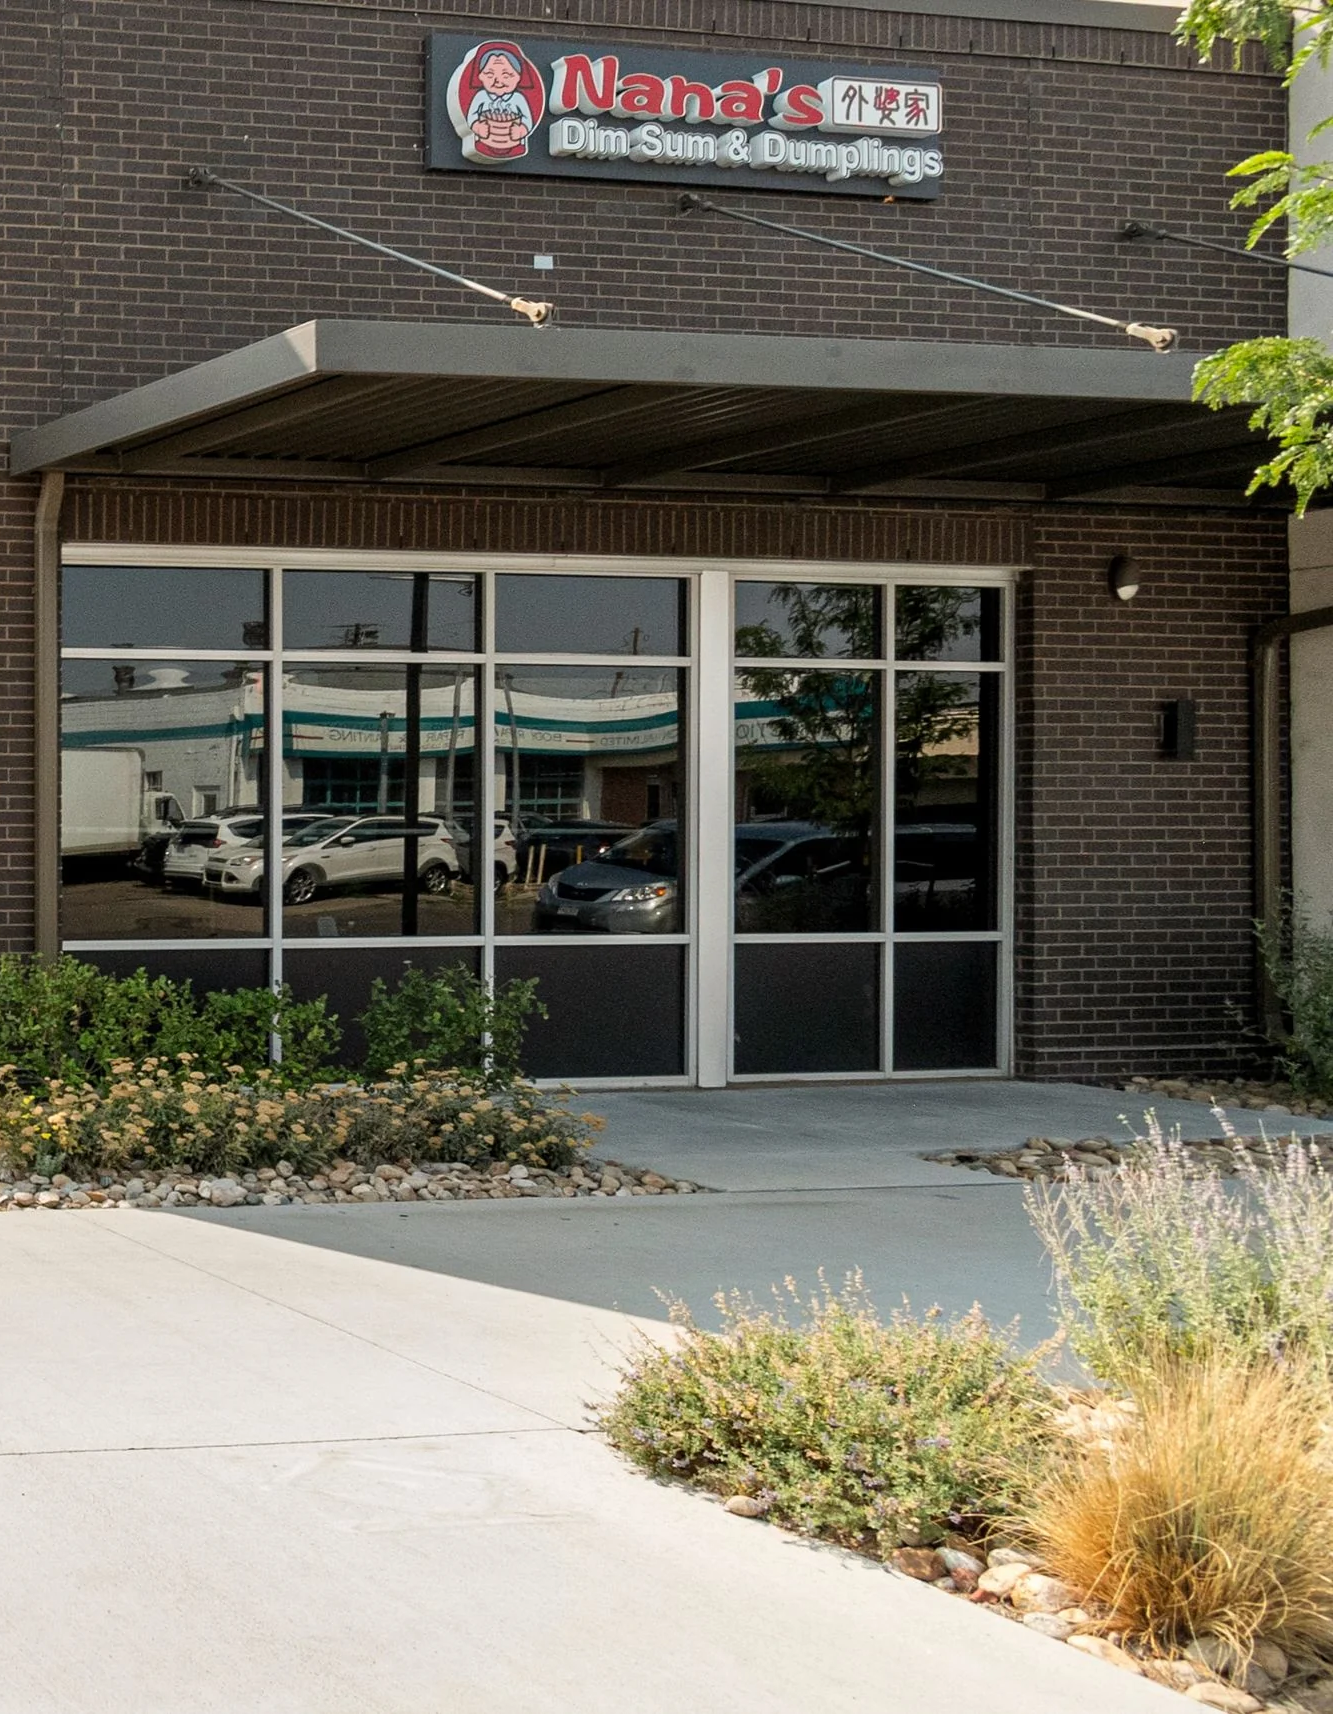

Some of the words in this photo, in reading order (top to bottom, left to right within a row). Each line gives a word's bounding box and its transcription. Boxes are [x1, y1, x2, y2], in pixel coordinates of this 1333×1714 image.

[559, 53, 826, 126] Nana's
[840, 84, 930, 127] 外婆家
[561, 118, 630, 155] Dim
[640, 121, 718, 161] Sum
[727, 128, 751, 164] &
[762, 131, 944, 183] Dumplings
